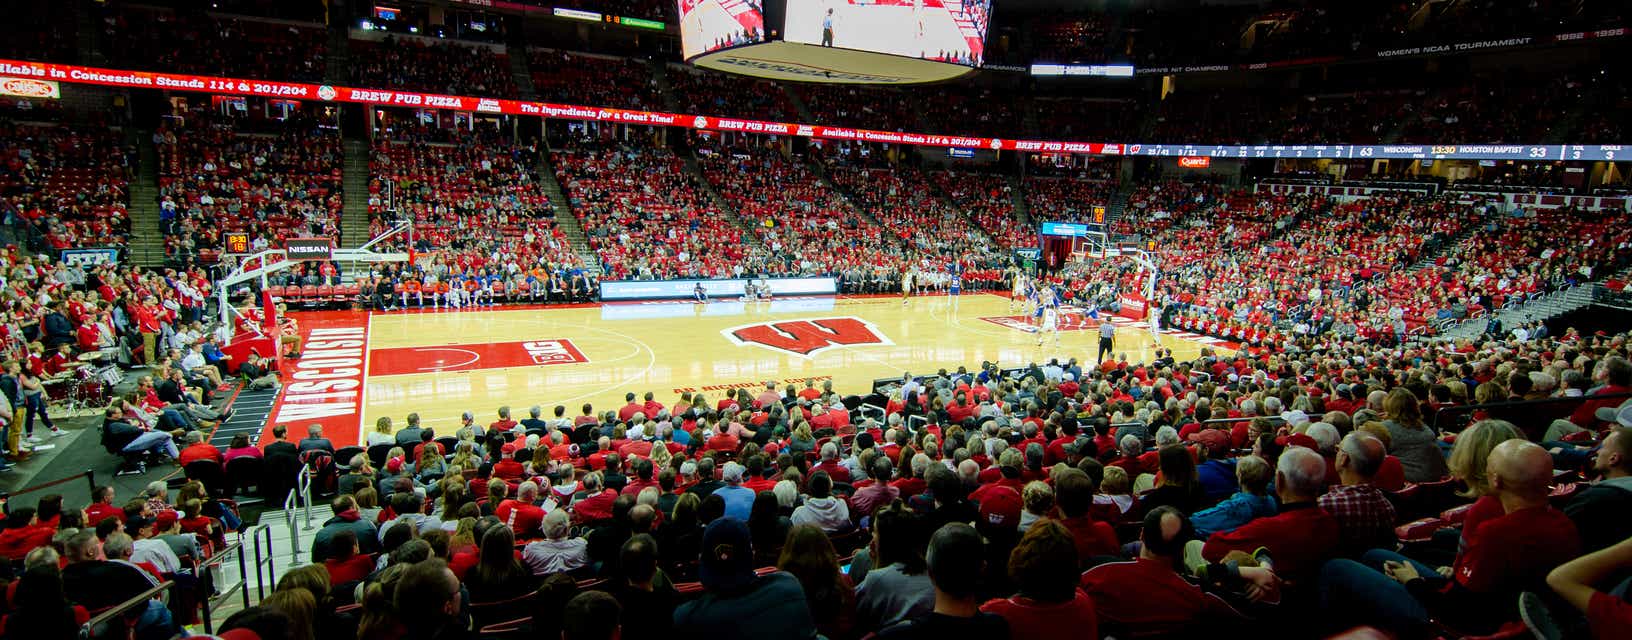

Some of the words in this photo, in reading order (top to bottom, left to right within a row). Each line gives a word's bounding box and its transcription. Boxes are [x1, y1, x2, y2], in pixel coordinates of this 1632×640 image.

[1377, 48, 1420, 57] WOMEN'S
[1423, 45, 1451, 53] NCAA
[1454, 37, 1532, 50] TOURNAMENT
[50, 65, 66, 78] in
[70, 69, 152, 85] Concession
[156, 76, 204, 89] Stands
[210, 80, 234, 90] 114
[238, 82, 250, 91] &
[254, 83, 307, 96] 201/204
[351, 90, 392, 103] BREW
[394, 93, 421, 105] PUB
[425, 96, 462, 108] PIZZA
[521, 104, 538, 113] The
[541, 105, 596, 117] Ingredients
[596, 110, 611, 120] for
[622, 112, 648, 121] Great
[650, 114, 674, 124] Time!
[718, 120, 744, 129] BREW
[746, 121, 762, 130] PUB
[764, 123, 788, 133] PIZZA
[823, 129, 855, 138] Available
[856, 130, 864, 138] in
[865, 132, 901, 142] Concession
[902, 134, 925, 143] Stands
[926, 135, 940, 144] 114
[1015, 141, 1042, 150] BREW
[1043, 142, 1062, 151] PUB
[1063, 143, 1090, 152] PIZZA
[1360, 147, 1373, 157] 63
[1384, 146, 1422, 154] WISCONSIN
[1431, 146, 1455, 154] 13:30
[1460, 146, 1492, 154] HOUSTON
[1494, 146, 1524, 154] BAPTIST
[1529, 147, 1546, 158] 33
[1573, 151, 1580, 159] 3
[1606, 151, 1614, 159] 3
[1182, 157, 1206, 167] Quartz
[289, 245, 329, 253] NISSAN
[275, 327, 365, 423] WISCONSIN
